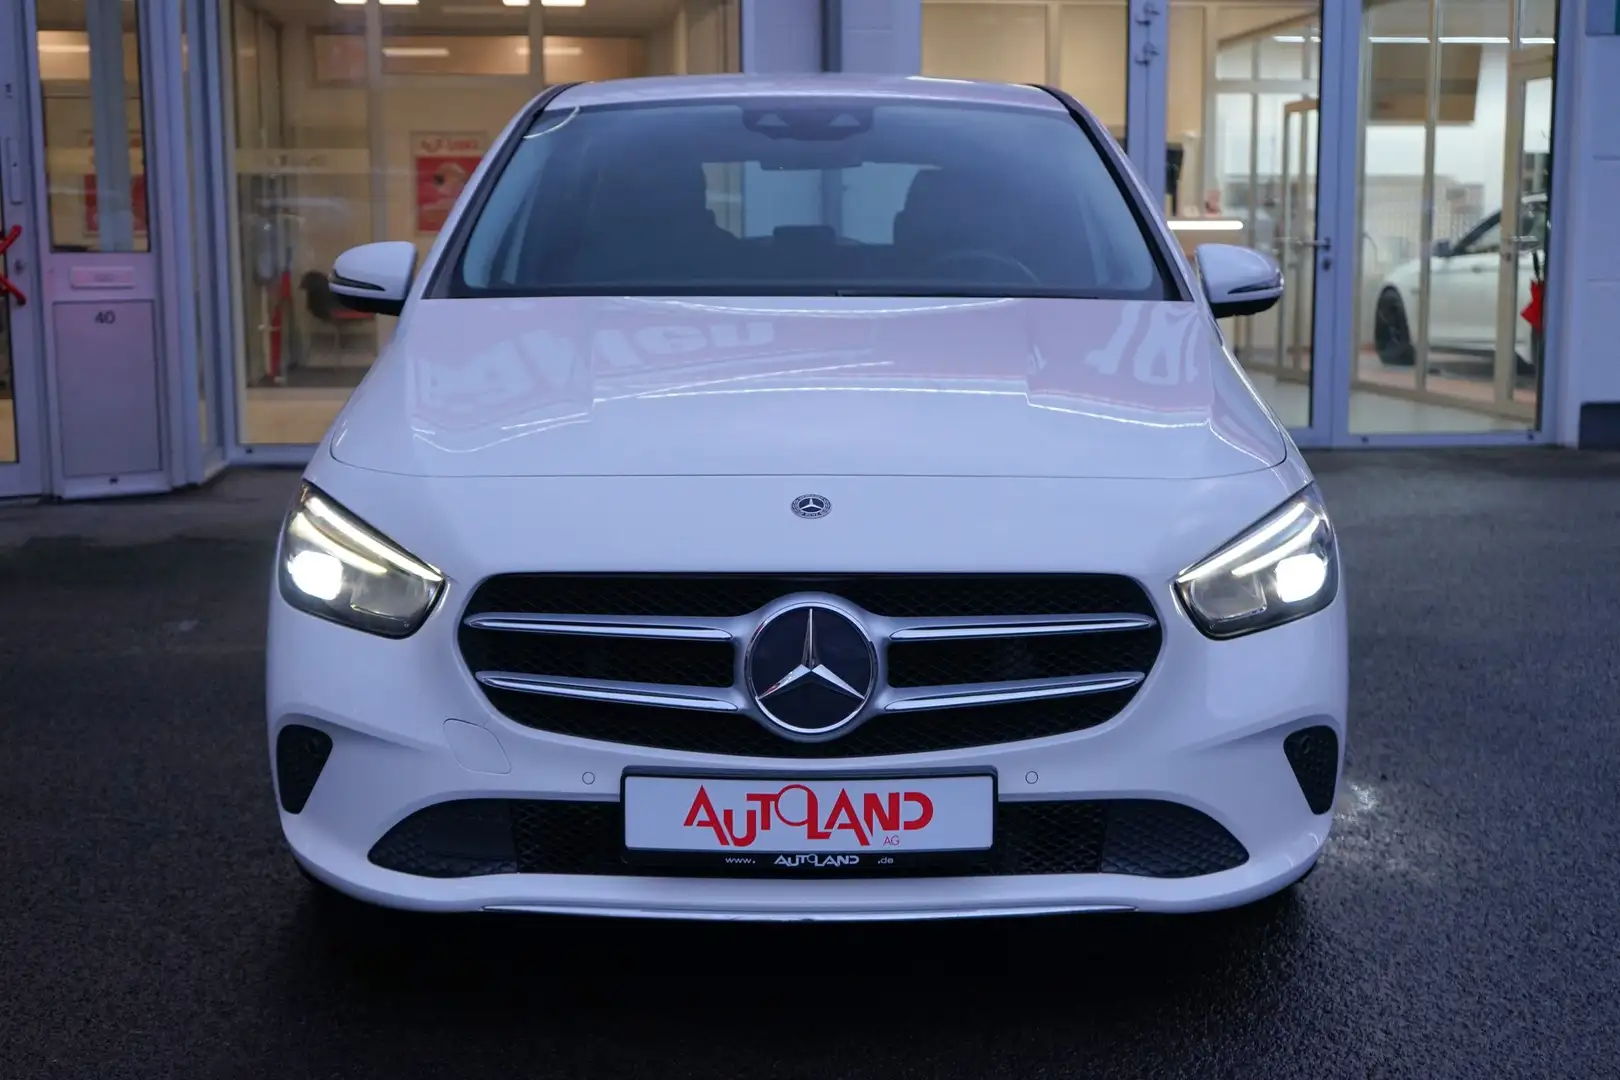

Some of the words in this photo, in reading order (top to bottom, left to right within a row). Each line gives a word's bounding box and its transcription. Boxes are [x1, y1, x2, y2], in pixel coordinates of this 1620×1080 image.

[95, 309, 116, 325] 40
[683, 784, 934, 847] AUTOLAND
[883, 835, 900, 847] AG
[725, 856, 756, 865] www.
[877, 856, 895, 865] .de
